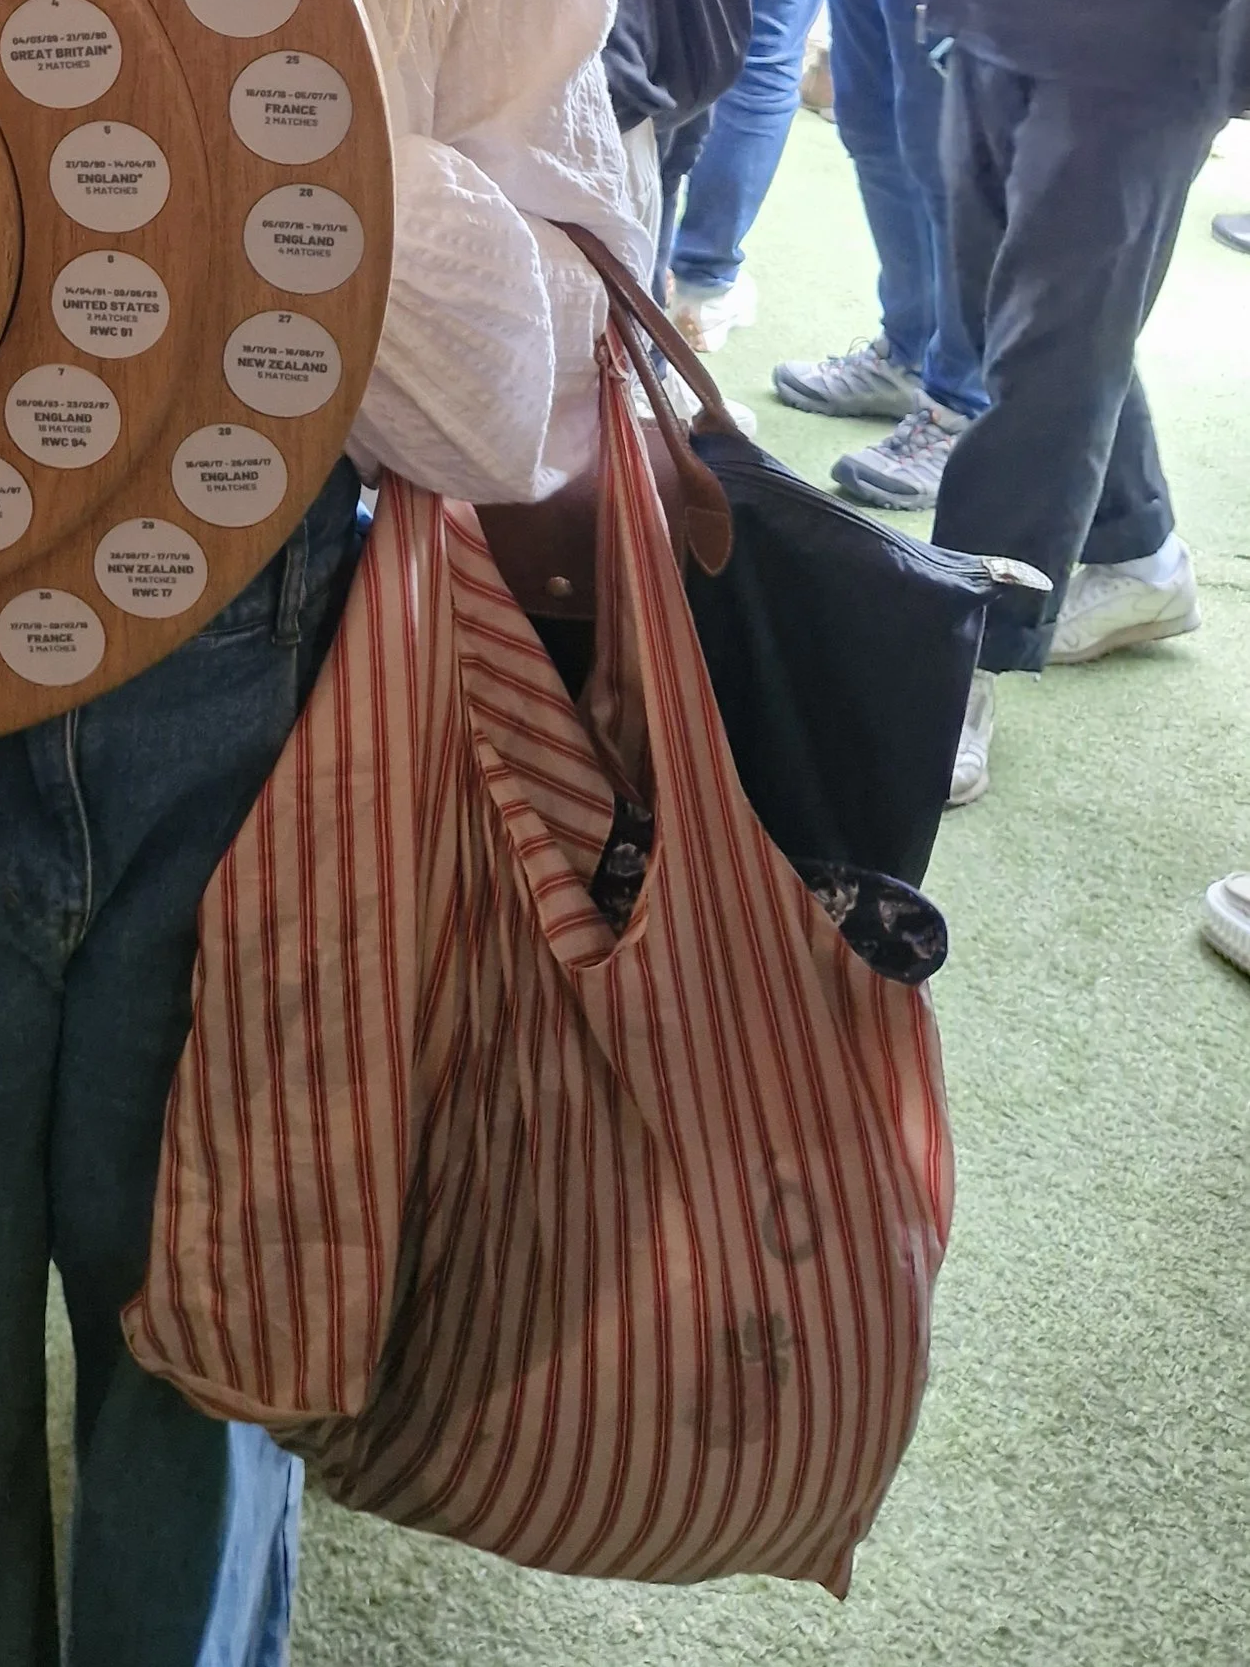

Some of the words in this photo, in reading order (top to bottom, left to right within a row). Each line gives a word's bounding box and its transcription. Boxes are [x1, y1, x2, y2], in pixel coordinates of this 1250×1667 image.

[10, 48, 52, 61] GREAT
[46, 60, 90, 70] MATCHES
[265, 103, 317, 115] FRANCE
[273, 117, 318, 127] MATCHES
[274, 234, 334, 246] ENGLAND
[286, 247, 331, 257] MATCHES
[63, 299, 107, 310] UNITED
[110, 302, 159, 313] STATES
[95, 313, 138, 323] MATCHES
[278, 315, 291, 323] 27
[90, 326, 117, 336] RWC
[238, 358, 266, 369] NEW
[269, 360, 327, 373] ZEALAND
[265, 372, 309, 382] MATCHES
[35, 412, 92, 423] ENGLAND
[49, 424, 91, 433] MATCHES
[42, 438, 68, 446] RWC
[201, 471, 259, 482] ENGLAND
[108, 565, 134, 574] NEW
[137, 565, 194, 574] ZEALAND
[135, 576, 176, 584] MATCHES
[132, 588, 158, 597] RWC
[162, 588, 172, 597] 17
[27, 634, 74, 643] FRANCE
[37, 644, 76, 652] MATCHES
